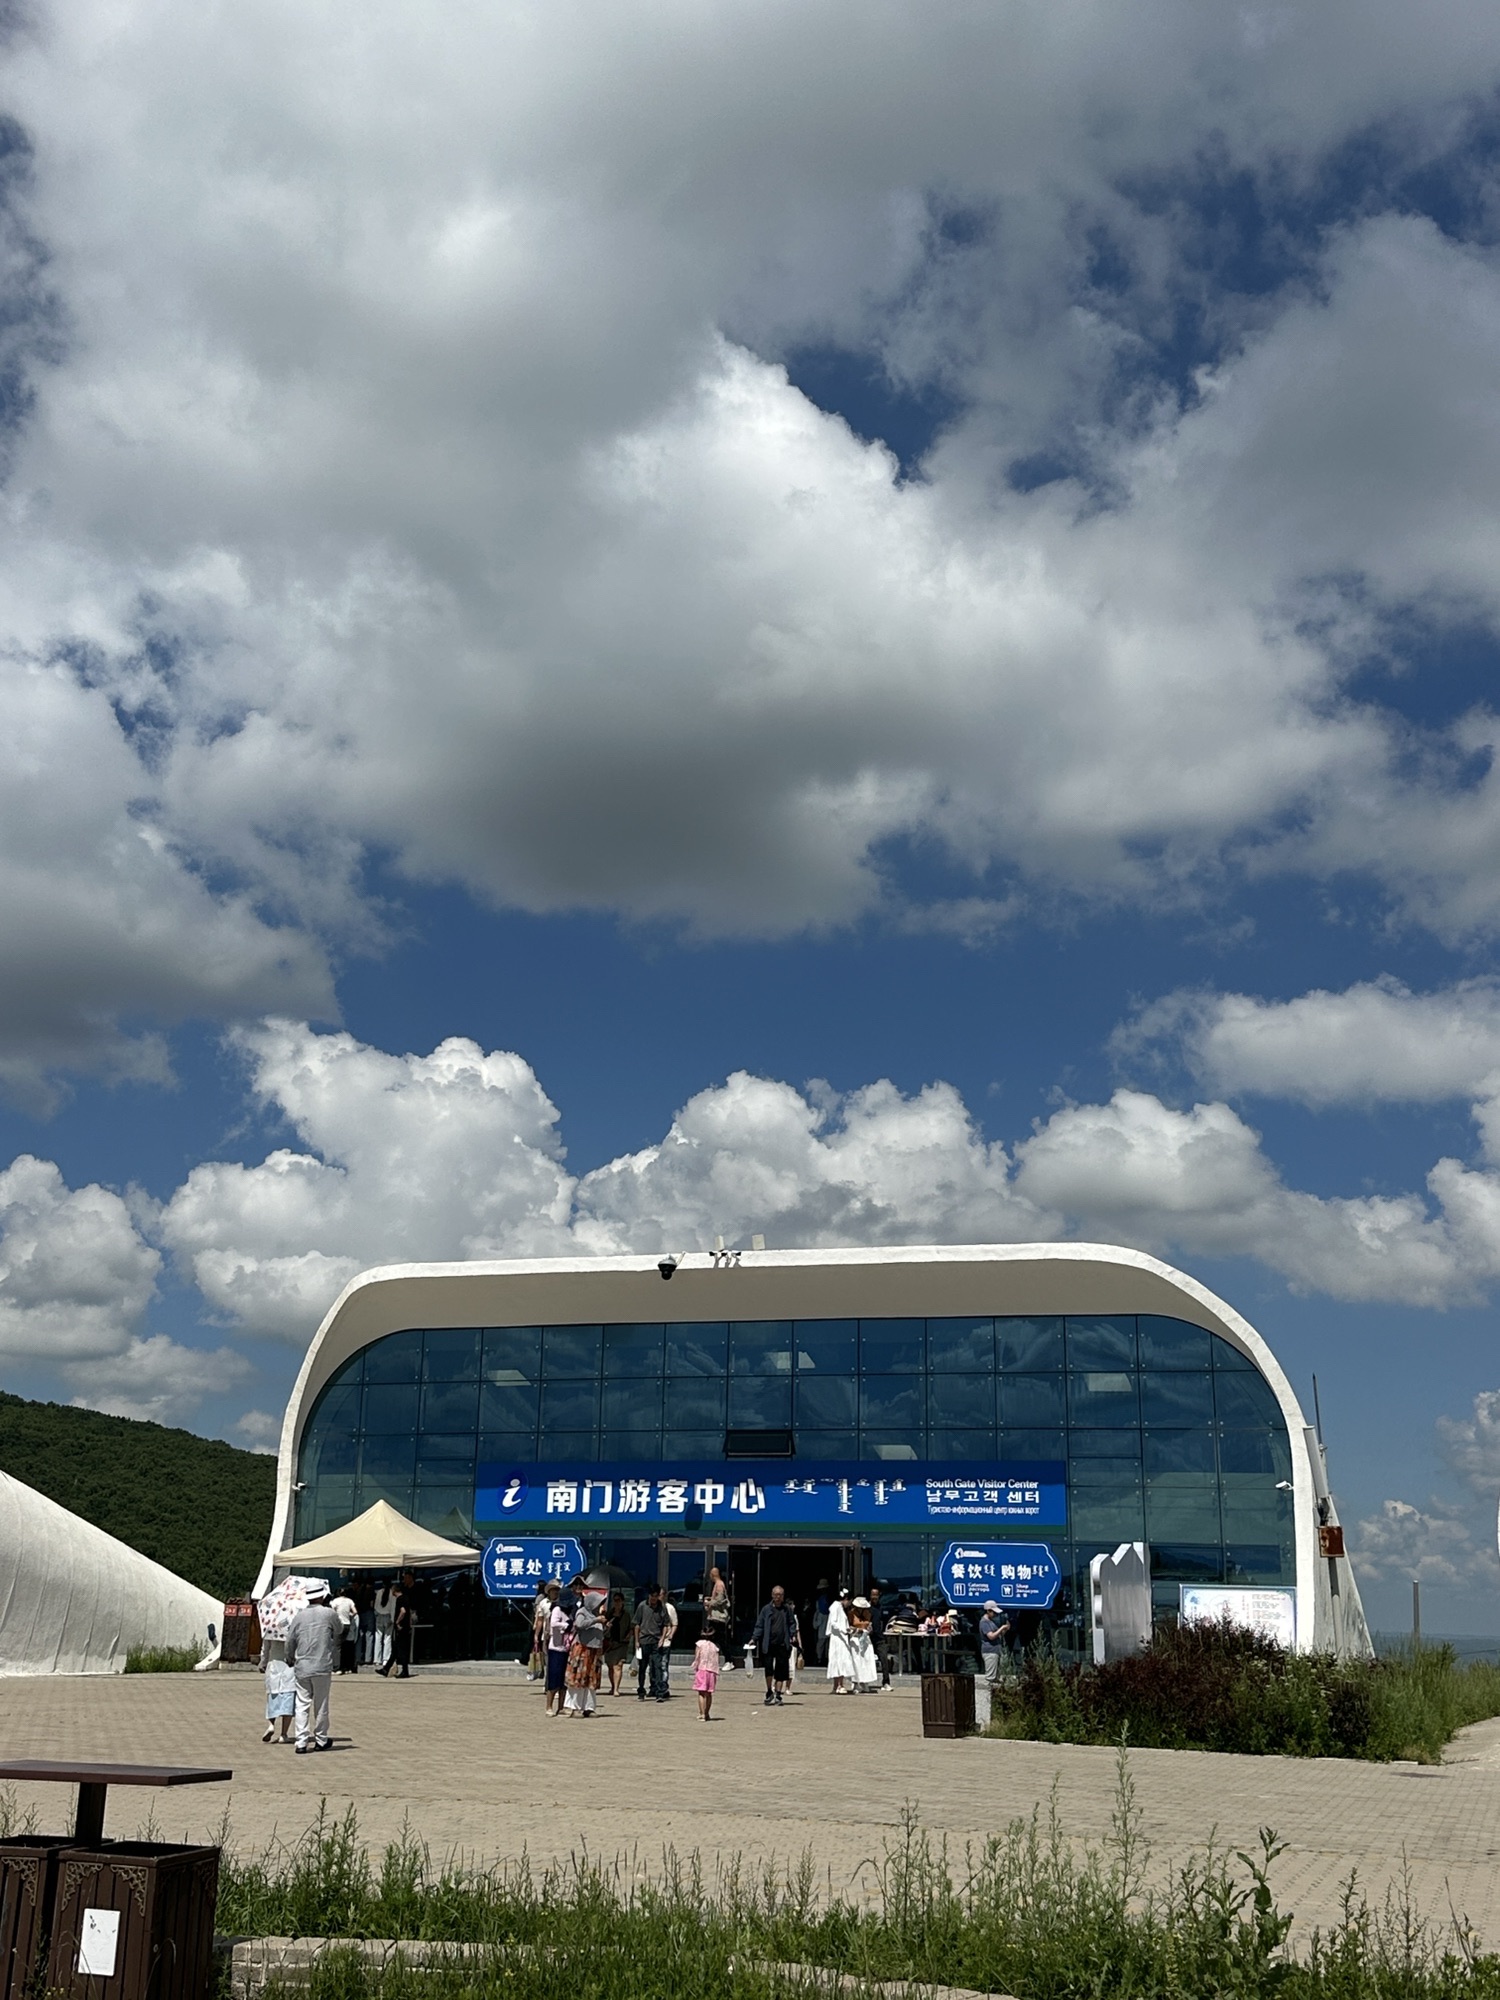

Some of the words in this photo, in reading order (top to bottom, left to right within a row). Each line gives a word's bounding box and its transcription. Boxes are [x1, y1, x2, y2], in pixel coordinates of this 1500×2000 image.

[925, 1478, 954, 1489] South
[954, 1478, 976, 1489] Gate
[977, 1478, 1007, 1489] Visitor
[1008, 1478, 1039, 1489] Center
[545, 1478, 766, 1514] 南门游客中心
[1006, 1490, 1040, 1504] 센터
[493, 1557, 543, 1577] 售票处
[951, 1563, 983, 1580] 餐饮
[1001, 1564, 1032, 1580] 购物
